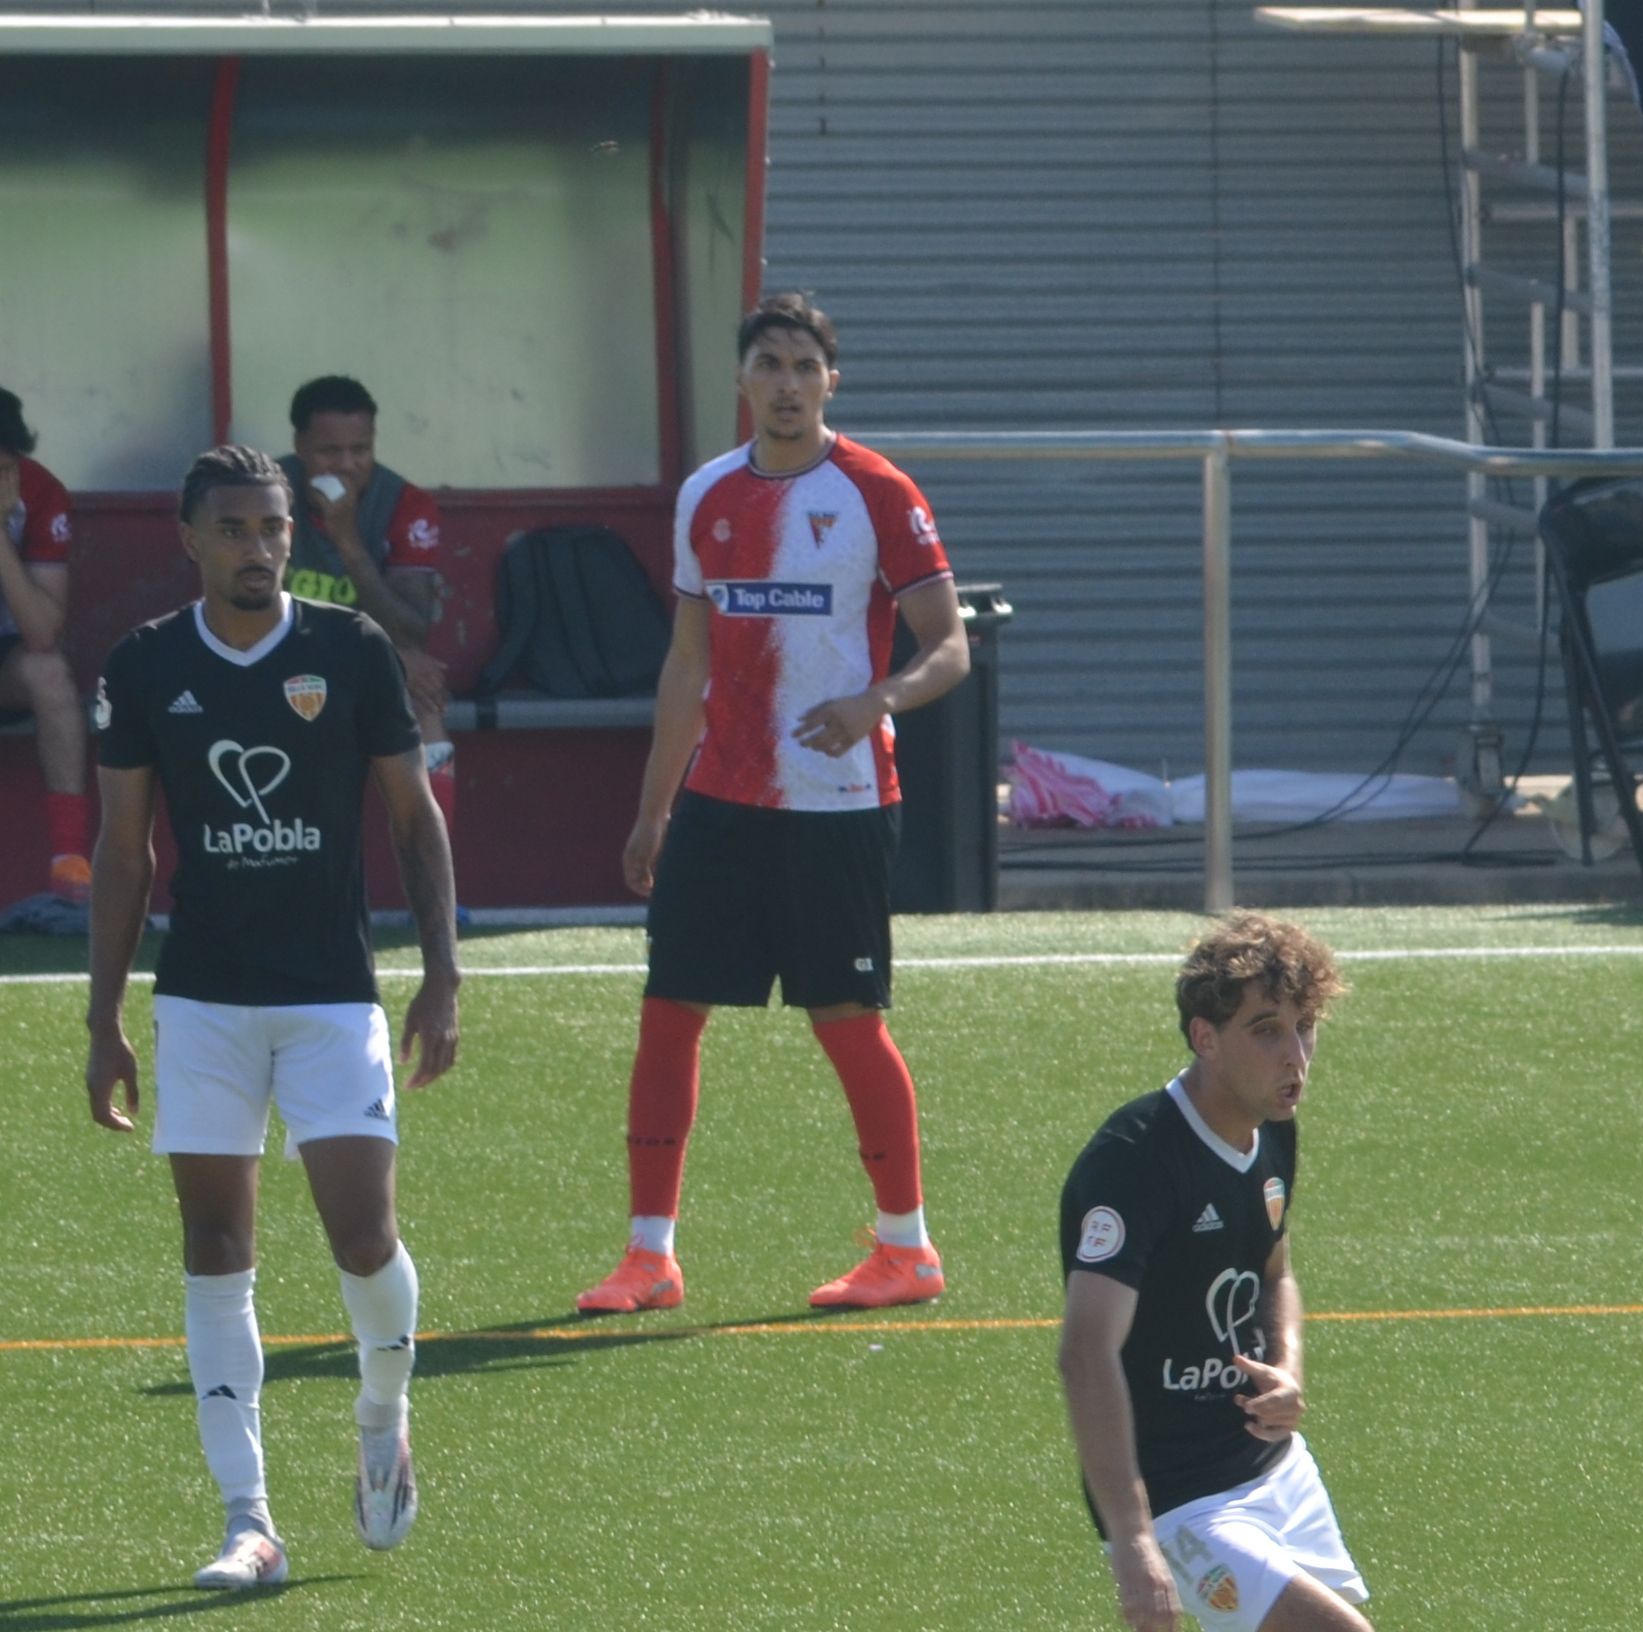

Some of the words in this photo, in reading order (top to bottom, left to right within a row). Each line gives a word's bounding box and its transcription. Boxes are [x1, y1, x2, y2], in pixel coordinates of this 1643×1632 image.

[291, 569, 357, 604] GIO
[734, 588, 766, 610] Top
[768, 588, 825, 608] Cable
[204, 817, 321, 853] LaPobla
[1163, 1346, 1262, 1390] LaPo
